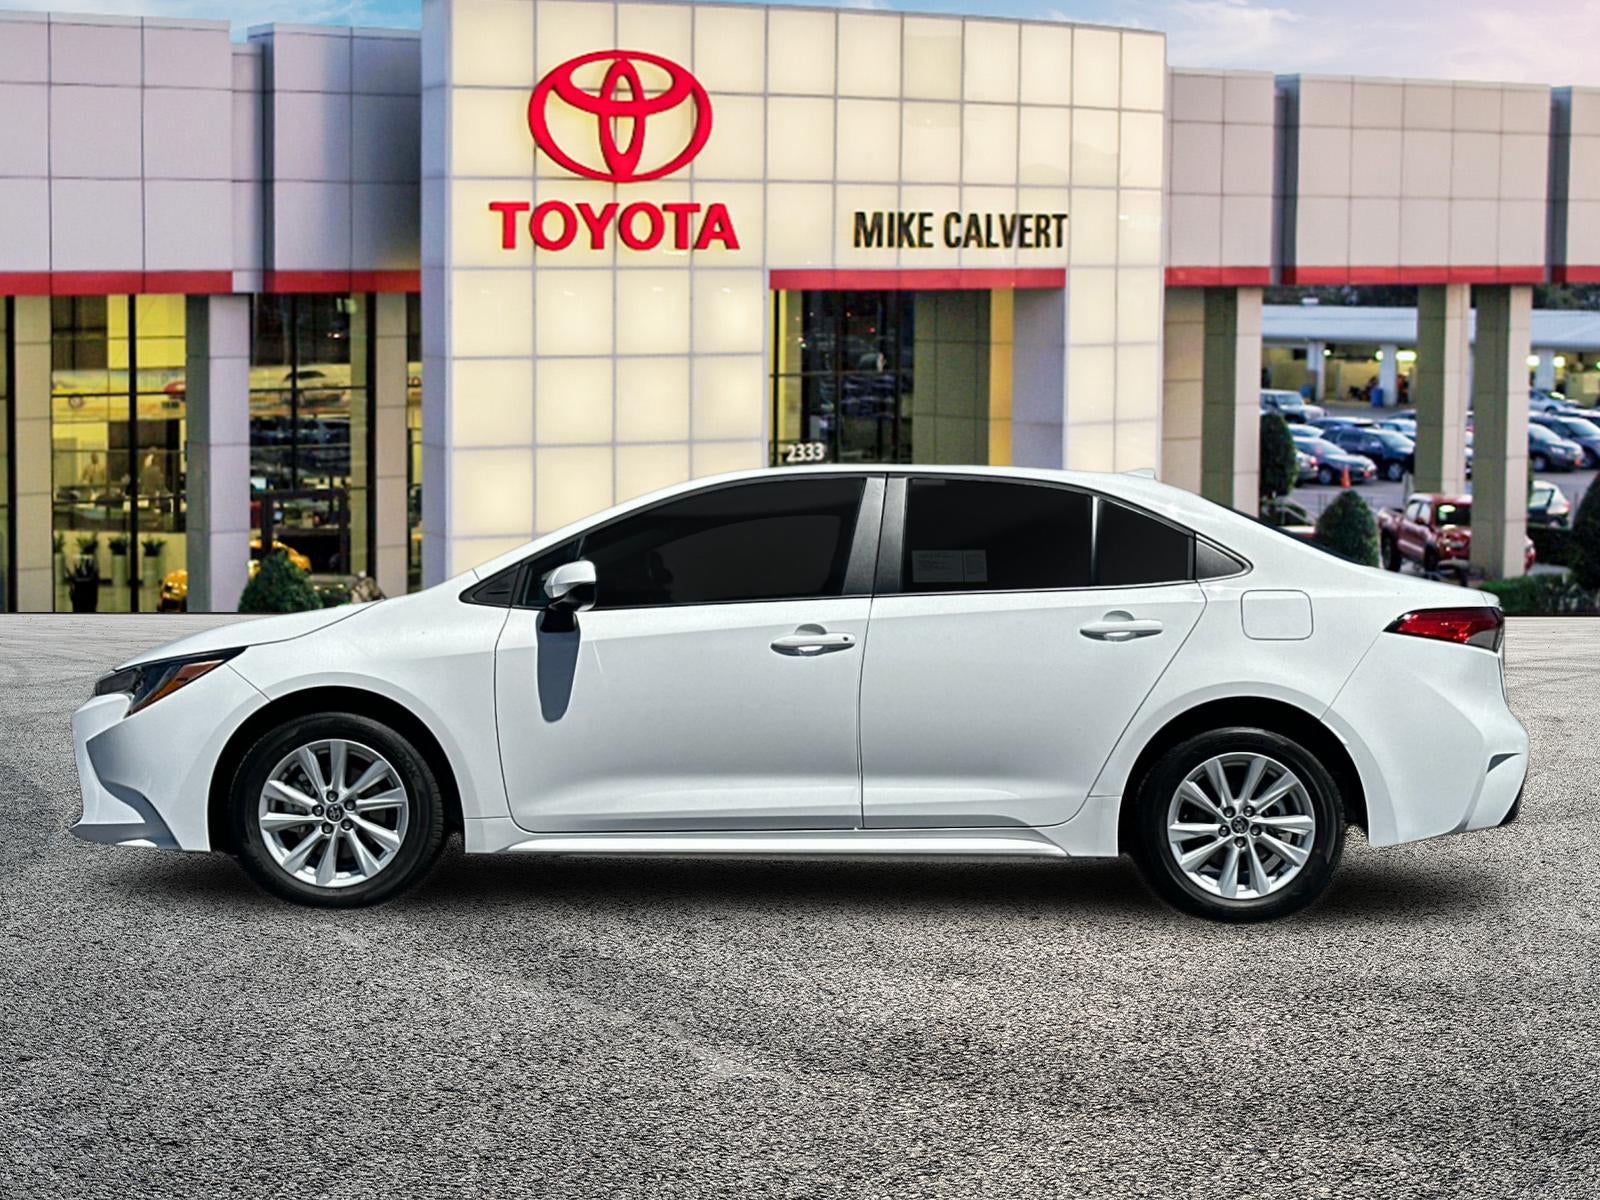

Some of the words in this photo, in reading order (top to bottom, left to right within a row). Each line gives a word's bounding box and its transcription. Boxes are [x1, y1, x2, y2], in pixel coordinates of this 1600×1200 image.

[489, 200, 741, 252] TOYOTA
[853, 211, 935, 249] MIKE
[943, 211, 1069, 249] CALVERT
[786, 442, 825, 462] 2333
